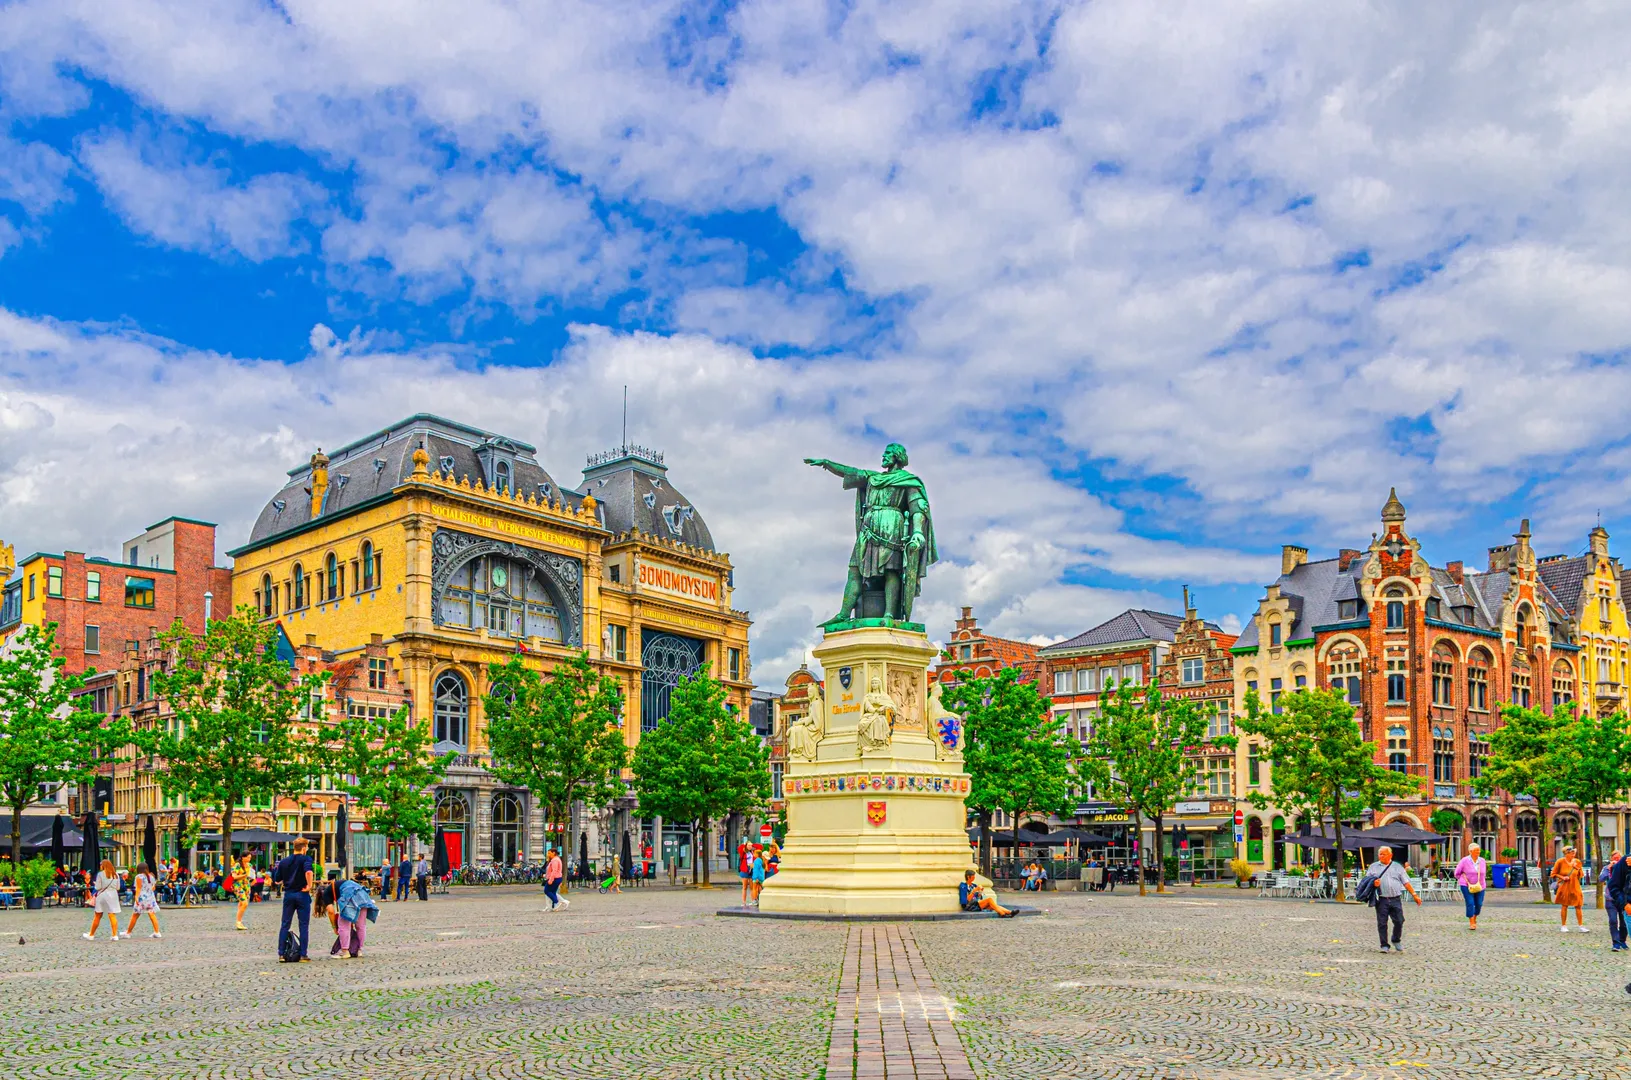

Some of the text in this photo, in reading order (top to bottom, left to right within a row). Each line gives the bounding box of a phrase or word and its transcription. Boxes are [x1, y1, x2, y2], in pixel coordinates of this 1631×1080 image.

[431, 504, 585, 549] SOCIALISTISCHE WERKERSVEREENIGINGEN
[1094, 813, 1129, 822] DE JACOB
